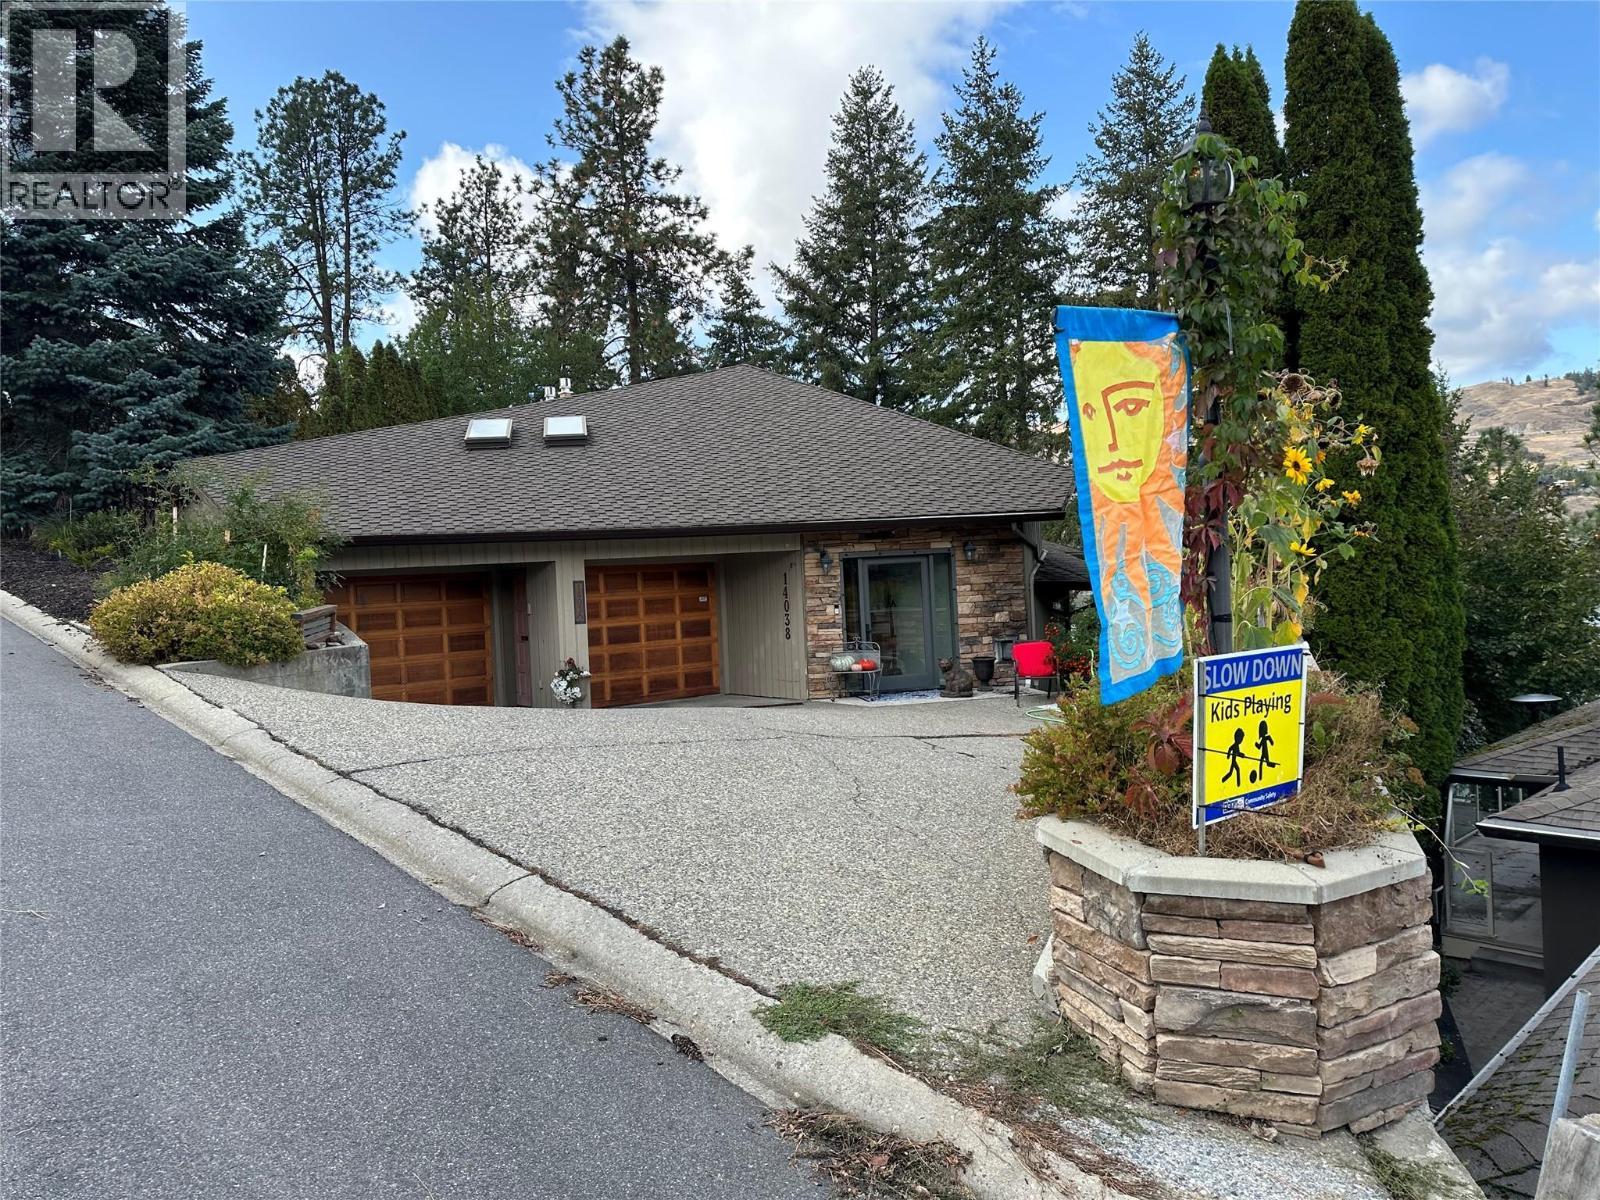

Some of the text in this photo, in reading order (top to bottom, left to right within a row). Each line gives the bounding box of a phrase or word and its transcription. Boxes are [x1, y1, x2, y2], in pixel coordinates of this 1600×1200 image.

[782, 572, 791, 640] 14038
[1205, 653, 1302, 690] SLOW DOWN
[1211, 692, 1292, 723] Kids Playing
